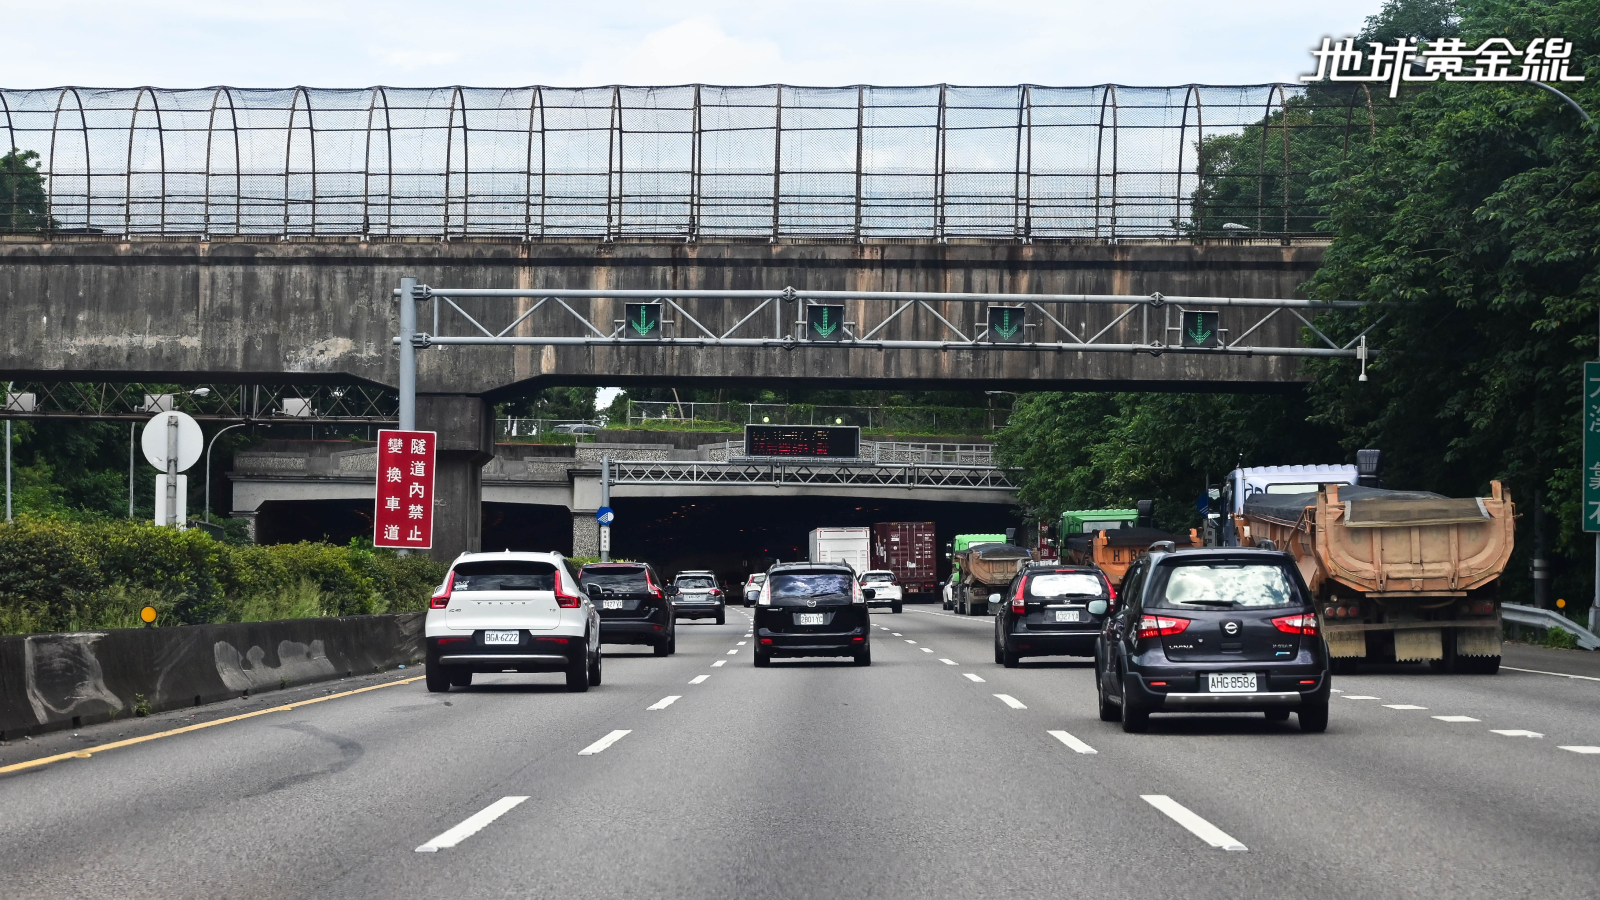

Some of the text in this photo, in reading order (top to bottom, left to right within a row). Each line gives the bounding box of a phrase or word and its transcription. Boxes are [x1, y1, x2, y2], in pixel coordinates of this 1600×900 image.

[384, 438, 403, 541] 變換車道
[407, 439, 427, 541] 隧道內禁止
[1211, 676, 1256, 689] AHG-8586
